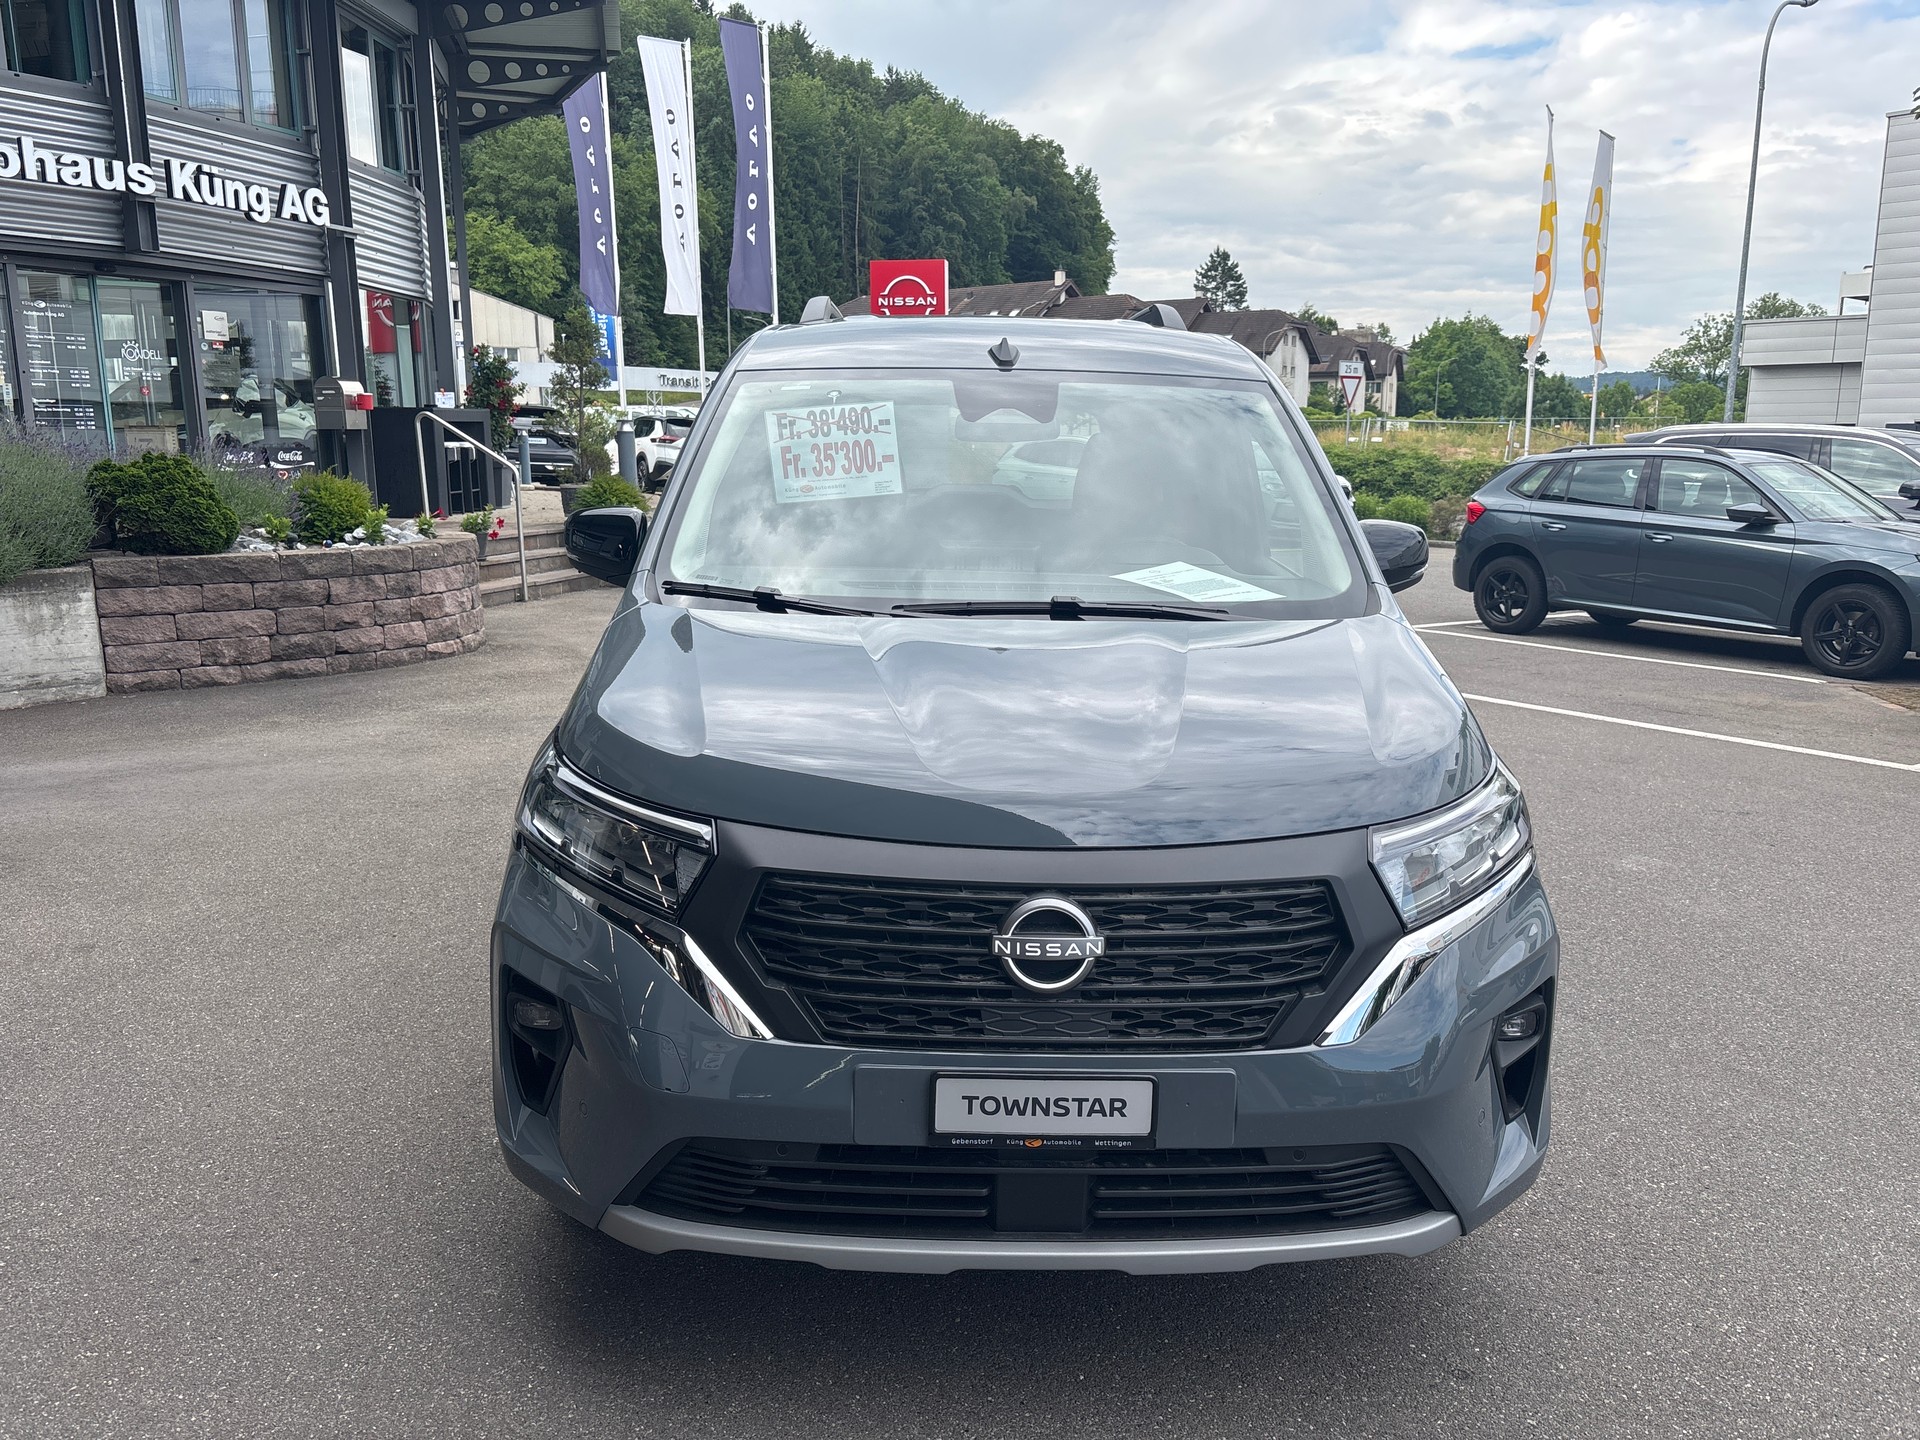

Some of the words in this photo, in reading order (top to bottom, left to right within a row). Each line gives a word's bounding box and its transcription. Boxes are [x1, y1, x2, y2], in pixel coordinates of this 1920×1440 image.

[166, 158, 272, 224] Küng
[277, 183, 331, 227] AG
[878, 296, 937, 306] NISSAN
[121, 344, 163, 361] RONDELL
[1345, 364, 1352, 374] 25
[660, 374, 699, 388] Transit
[777, 412, 802, 440] Fr.
[781, 445, 807, 480] Fr.
[994, 940, 1102, 957] NISSAN
[962, 1095, 1128, 1118] TOWNSTAR
[951, 1137, 994, 1146] Gebenstorf
[1006, 1138, 1024, 1147] Küng
[1043, 1138, 1082, 1146] Automobile
[1095, 1138, 1132, 1147] Wettingen
